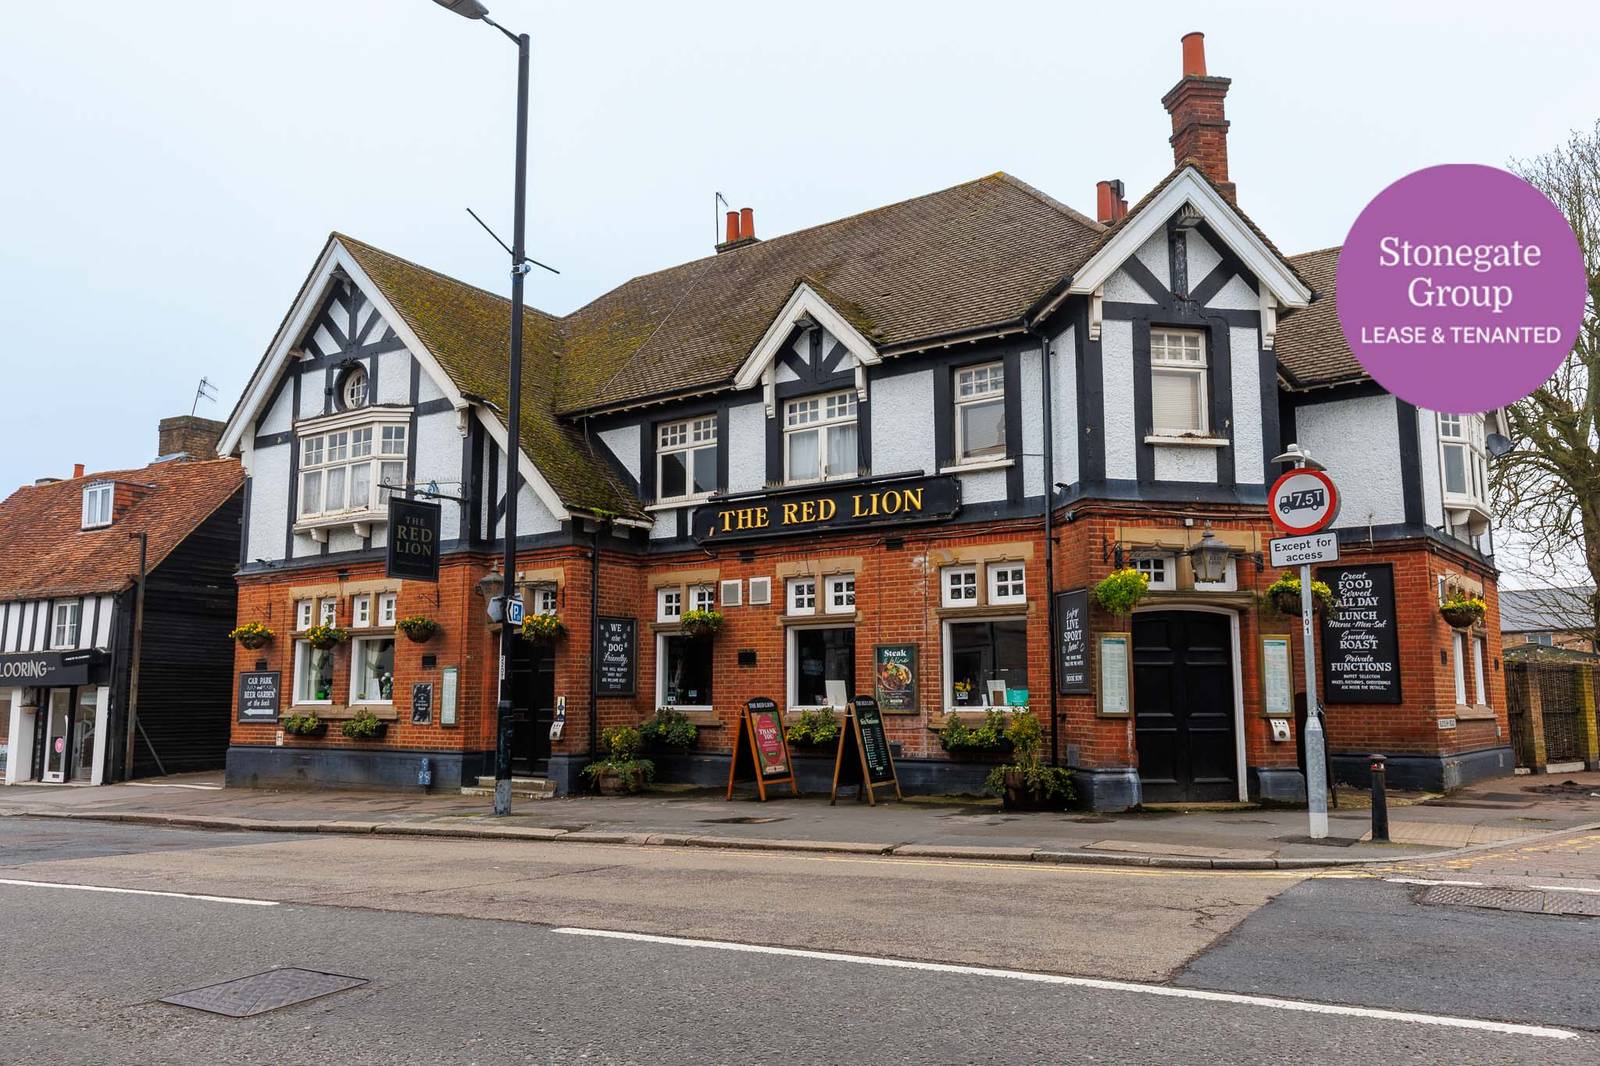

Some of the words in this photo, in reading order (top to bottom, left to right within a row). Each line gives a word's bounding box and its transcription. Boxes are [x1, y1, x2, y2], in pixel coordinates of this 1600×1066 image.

[1293, 490, 1322, 506] 7.5T
[718, 506, 770, 532] THE
[782, 498, 837, 525] RED
[852, 487, 924, 518] LION
[406, 516, 425, 526] THE
[396, 525, 432, 542] RED
[396, 541, 432, 556] LION
[1274, 540, 1311, 552] Except
[1317, 538, 1332, 547] for
[1286, 552, 1323, 562] access
[1341, 571, 1368, 580] Great
[1338, 579, 1373, 589] FOOD
[1340, 588, 1372, 598] Served
[1335, 597, 1356, 608] ALL
[1357, 597, 1379, 607] DAY
[513, 605, 519, 619] P
[1339, 611, 1378, 620] LUNCH
[610, 623, 622, 632] WE
[1066, 619, 1080, 630] LIVE
[1327, 619, 1351, 628] Menu
[1063, 630, 1082, 642] SPORT
[1341, 631, 1377, 642] Sunday
[608, 643, 623, 652] DOG
[1339, 640, 1378, 649] ROAST
[884, 649, 907, 657] Steak
[1344, 654, 1374, 663] Private
[1330, 662, 1392, 672] FUNCTIONS
[247, 677, 258, 685] CAR
[259, 677, 273, 685] PARK
[244, 690, 256, 699] BEER
[256, 689, 276, 699] GARDEN
